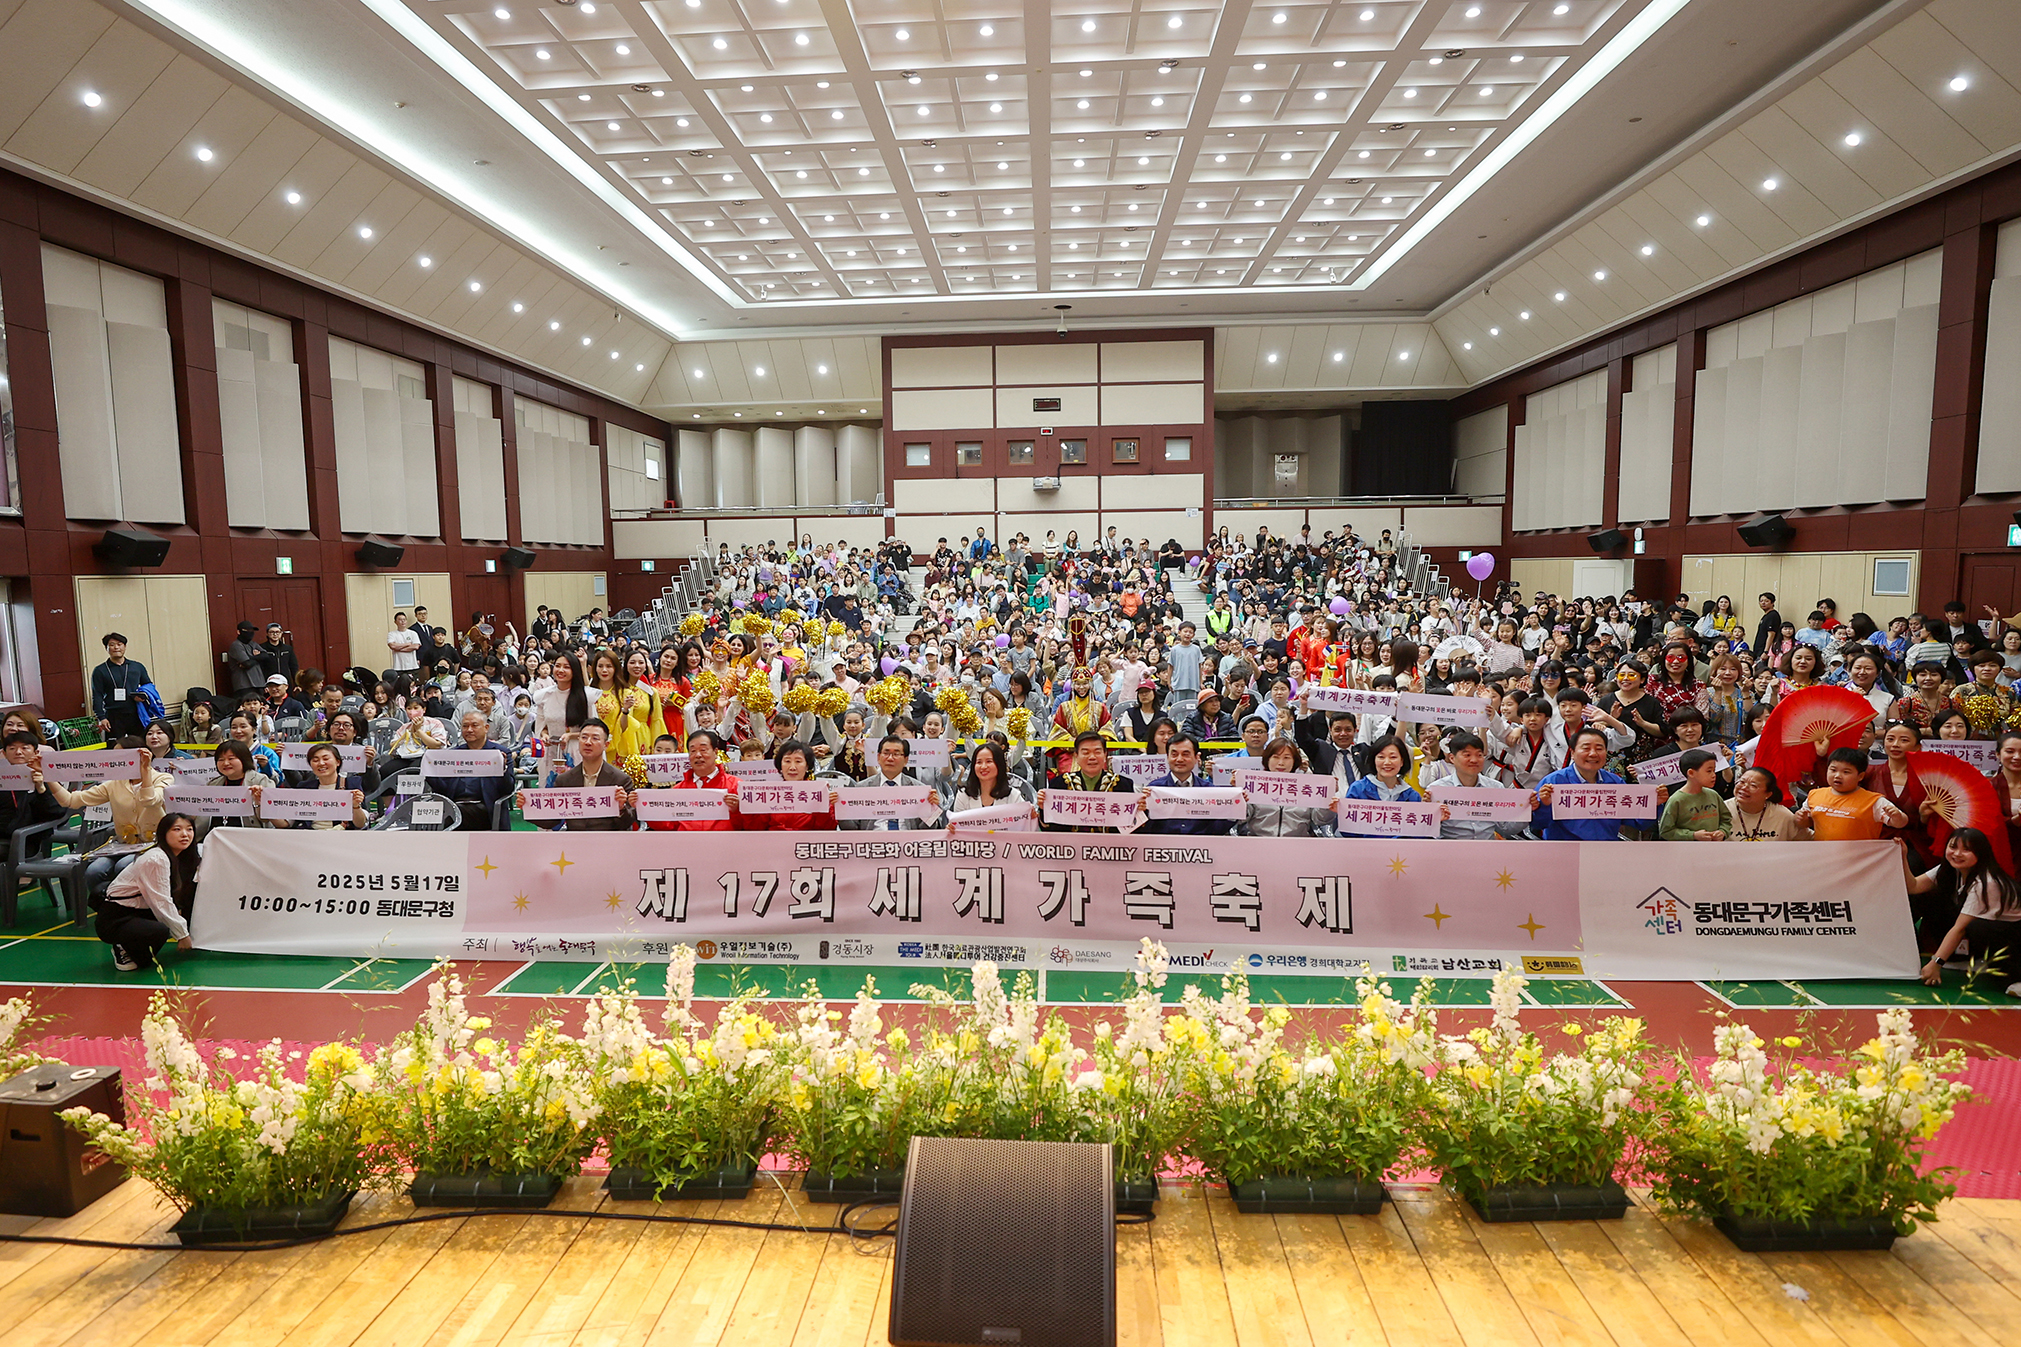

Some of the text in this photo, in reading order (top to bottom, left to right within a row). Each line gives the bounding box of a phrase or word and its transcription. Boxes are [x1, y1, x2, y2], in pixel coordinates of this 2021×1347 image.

[1243, 781, 1328, 798] 세계가족축제
[530, 796, 611, 810] 세계가족축제
[742, 791, 823, 803] 세계가족축제
[1558, 795, 1649, 808] 세계가족축제
[1051, 802, 1135, 815] 세계가족축제
[1345, 810, 1433, 826] 세계가족축제
[795, 842, 853, 859] 동대문구
[856, 842, 900, 859] 다문화
[904, 840, 948, 858] 어울림
[950, 840, 995, 859] 한마당
[1018, 844, 1076, 859] WORLD
[1082, 846, 1136, 861] FAMILY
[1144, 848, 1213, 863] FESTIVAL
[317, 874, 384, 891] 2025년
[238, 895, 454, 917] 10:00~15:00 동대문구청
[1644, 899, 1678, 921] 가족
[1693, 901, 1853, 923] 동대문구가족센터
[1644, 915, 1682, 935] 센터
[1696, 926, 1856, 936] DONGDAEMUNGU FAMILY CENTER
[462, 938, 488, 951] 주최
[642, 942, 668, 955] 후원
[832, 944, 874, 955] 경동시장
[769, 952, 800, 960] Technology
[1075, 950, 1112, 958] DAESANG
[1266, 955, 1307, 967] 우리은행
[1442, 958, 1502, 972] 남산교회
